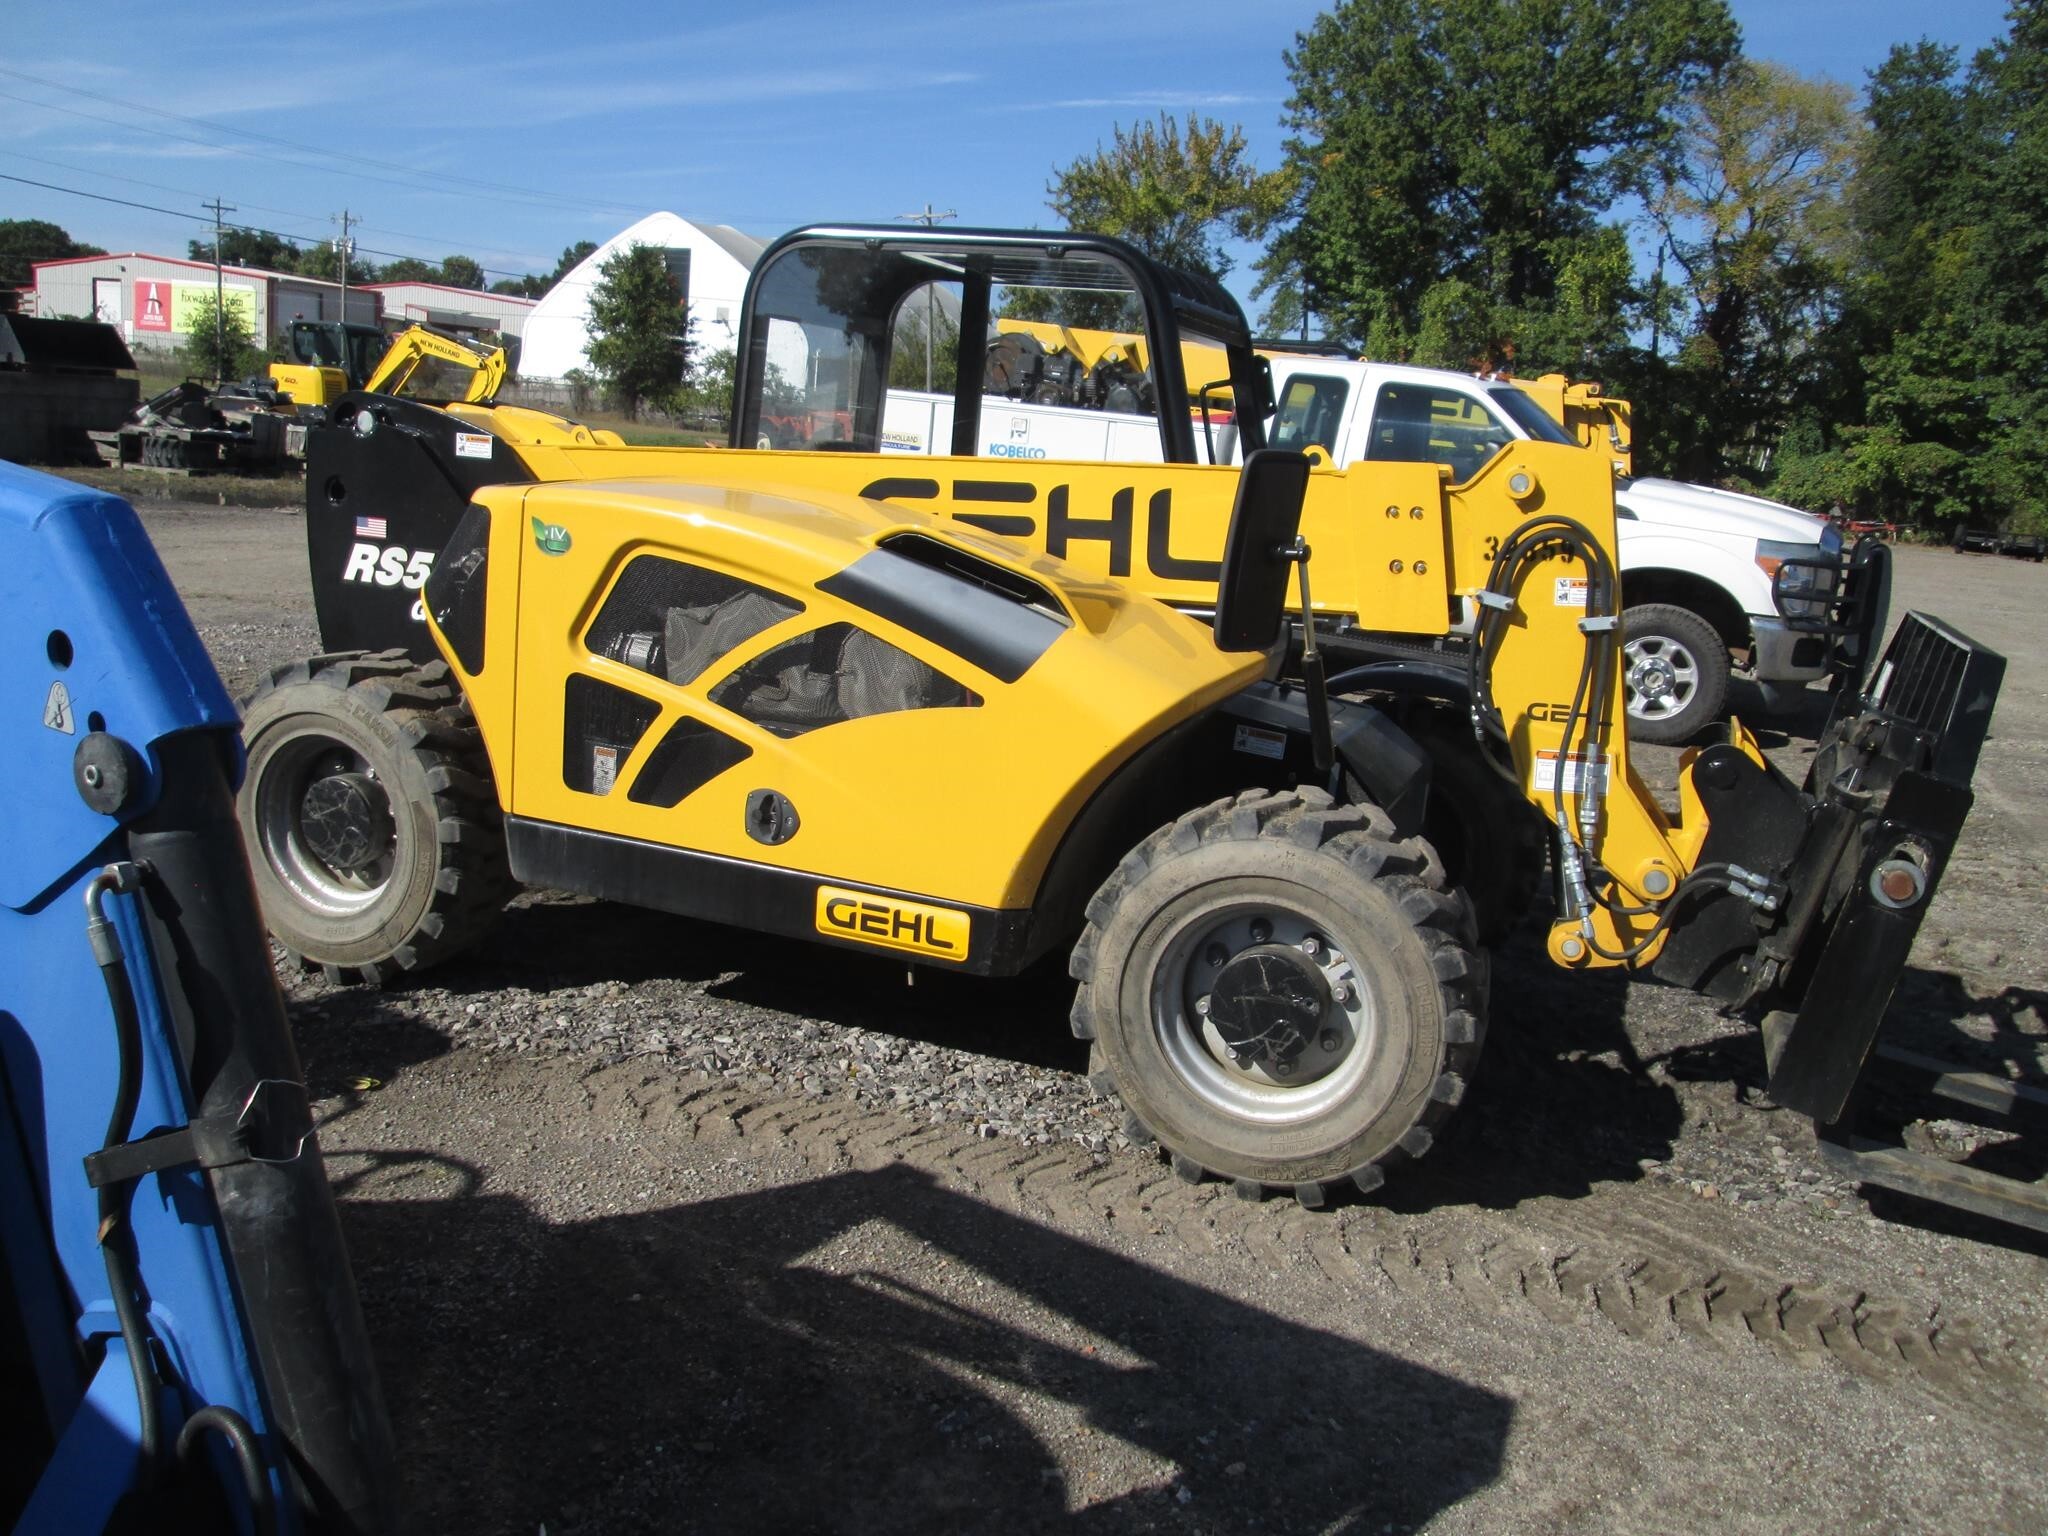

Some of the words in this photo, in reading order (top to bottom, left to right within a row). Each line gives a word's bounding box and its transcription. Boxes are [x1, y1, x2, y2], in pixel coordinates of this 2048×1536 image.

[434, 343, 461, 359] HOLLAND
[892, 433, 919, 443] HOLLAND
[989, 442, 1046, 459] KOBELCO
[826, 897, 954, 950] GEHL
